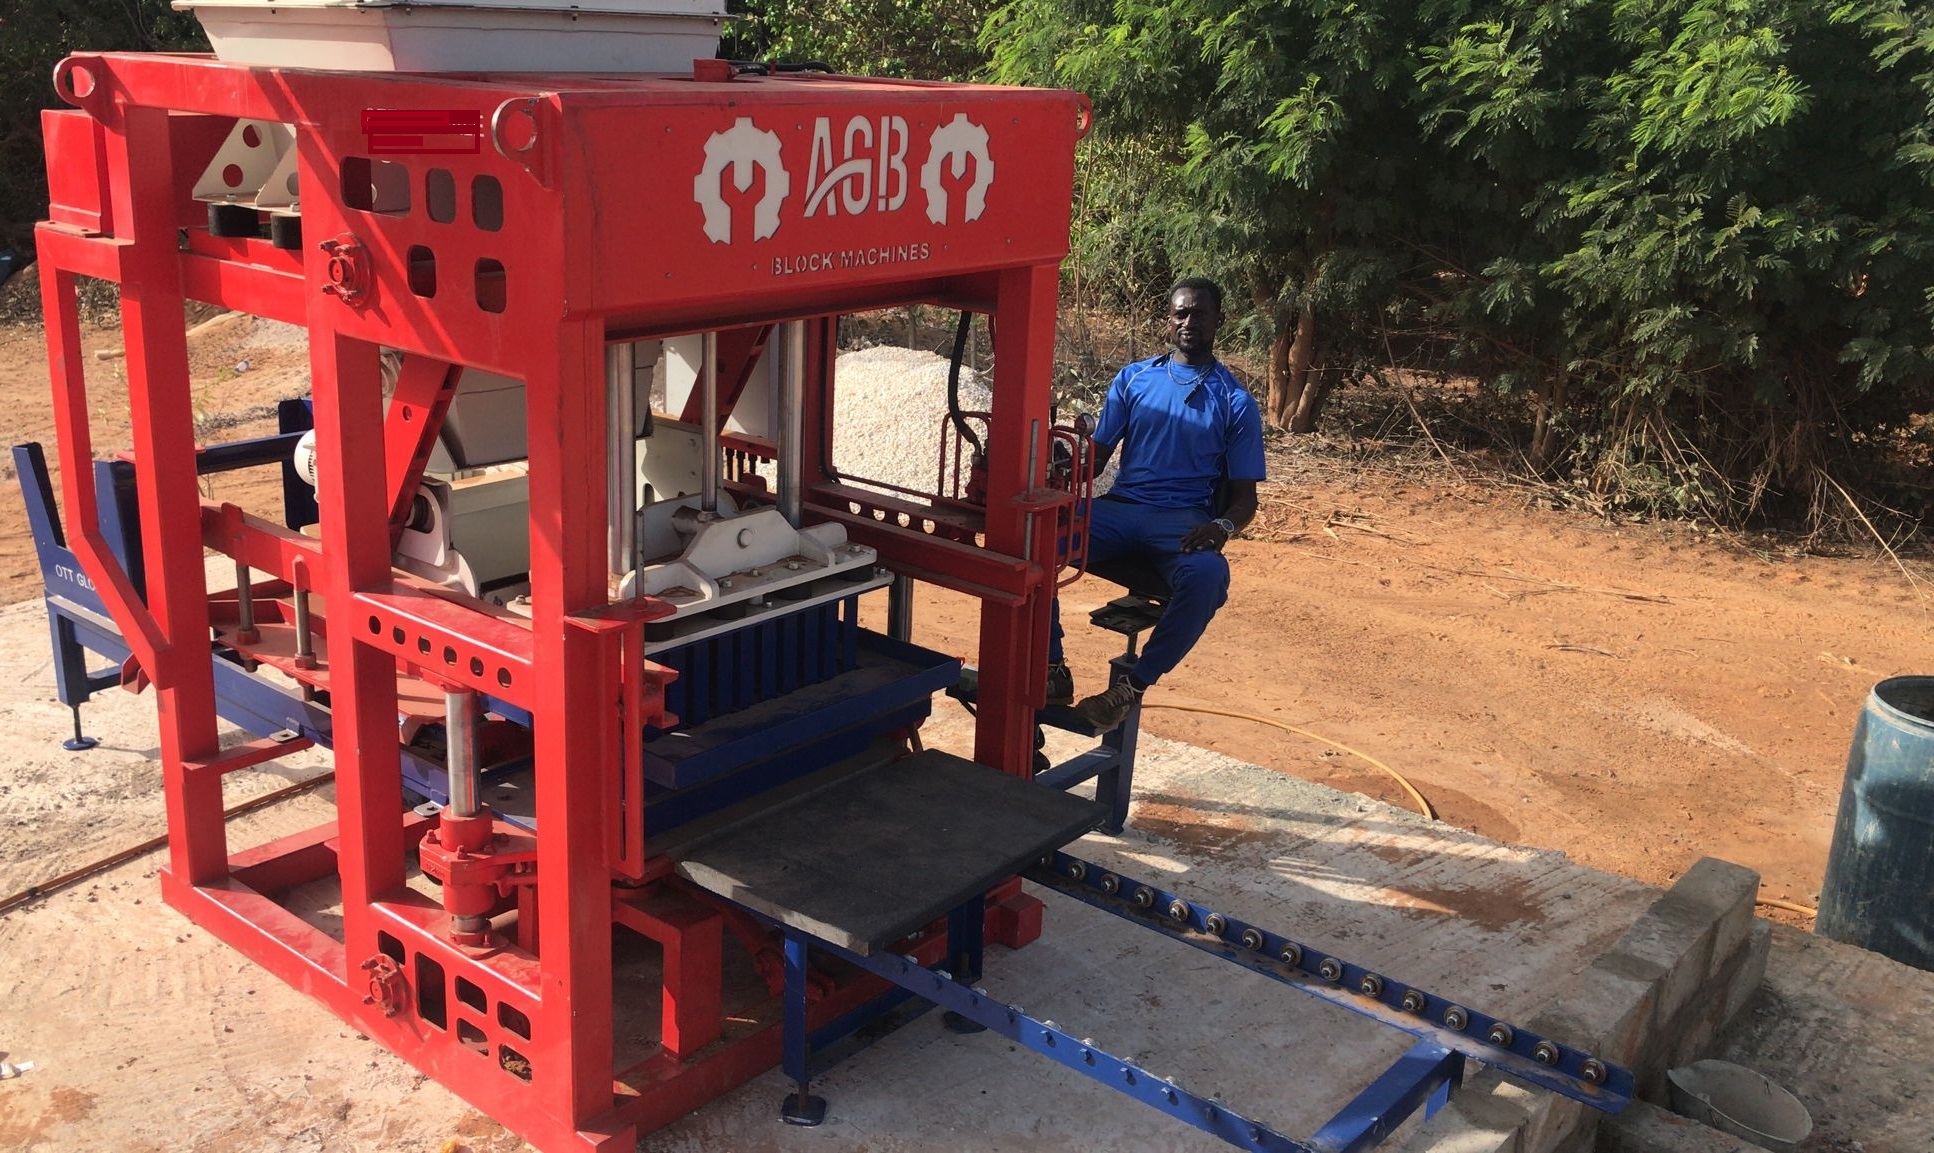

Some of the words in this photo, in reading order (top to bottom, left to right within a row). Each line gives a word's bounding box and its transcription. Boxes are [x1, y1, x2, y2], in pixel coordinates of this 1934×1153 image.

[803, 115, 909, 217] AGB
[772, 251, 833, 275] BLOCK
[841, 243, 930, 267] MACHINES
[55, 564, 73, 582] OTT
